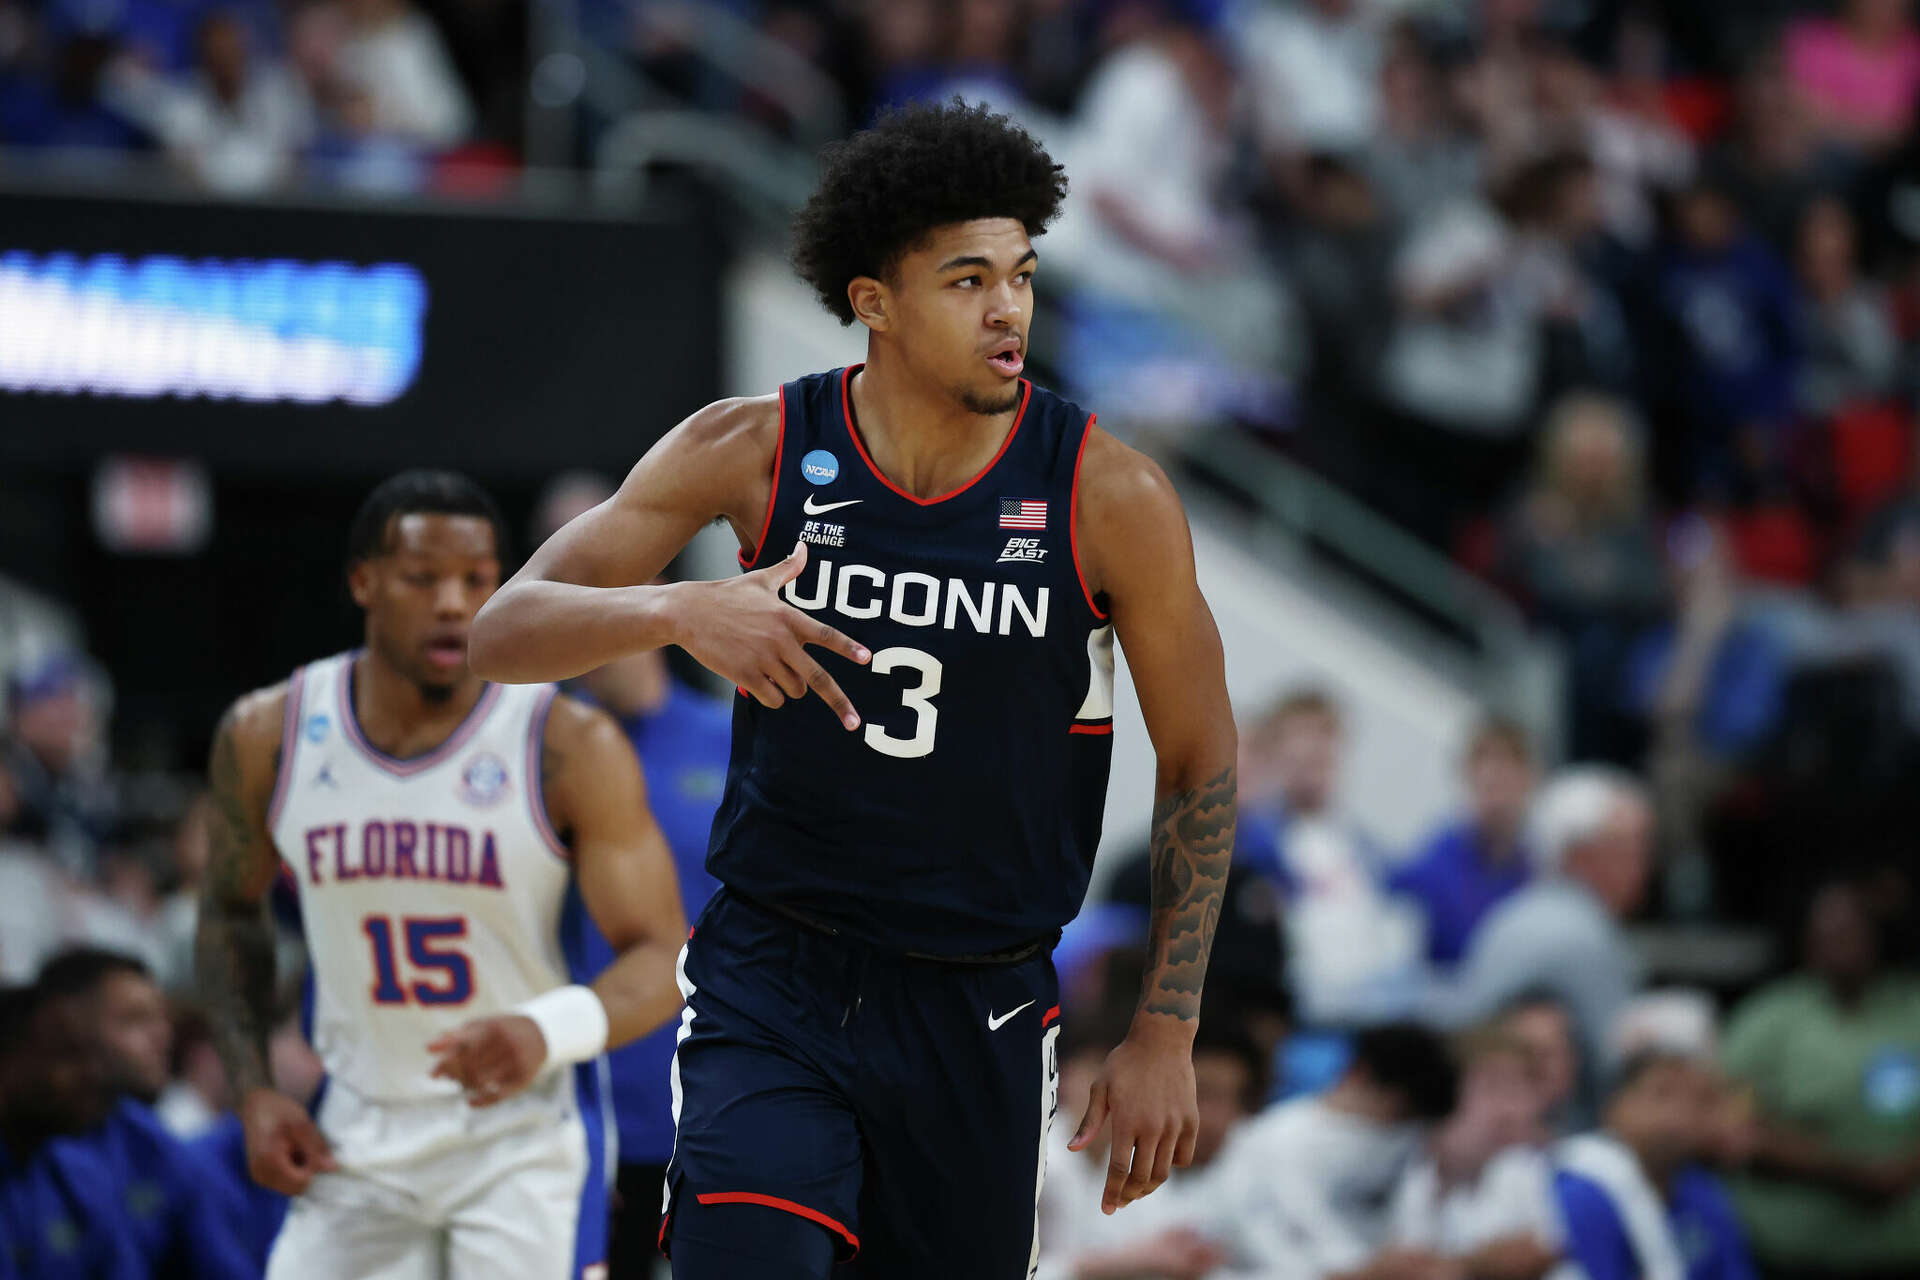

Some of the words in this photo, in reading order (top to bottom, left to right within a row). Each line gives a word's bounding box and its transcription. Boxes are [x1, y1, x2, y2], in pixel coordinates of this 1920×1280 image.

[799, 531, 845, 547] CHANGE
[804, 521, 820, 533] BE
[823, 523, 845, 536] THE
[1006, 538, 1040, 548] BIG
[1000, 548, 1048, 558] EAST
[785, 555, 1049, 638] UCONN
[864, 646, 943, 758] 3
[305, 820, 505, 890] FLORIDA
[361, 914, 476, 1005] 15
